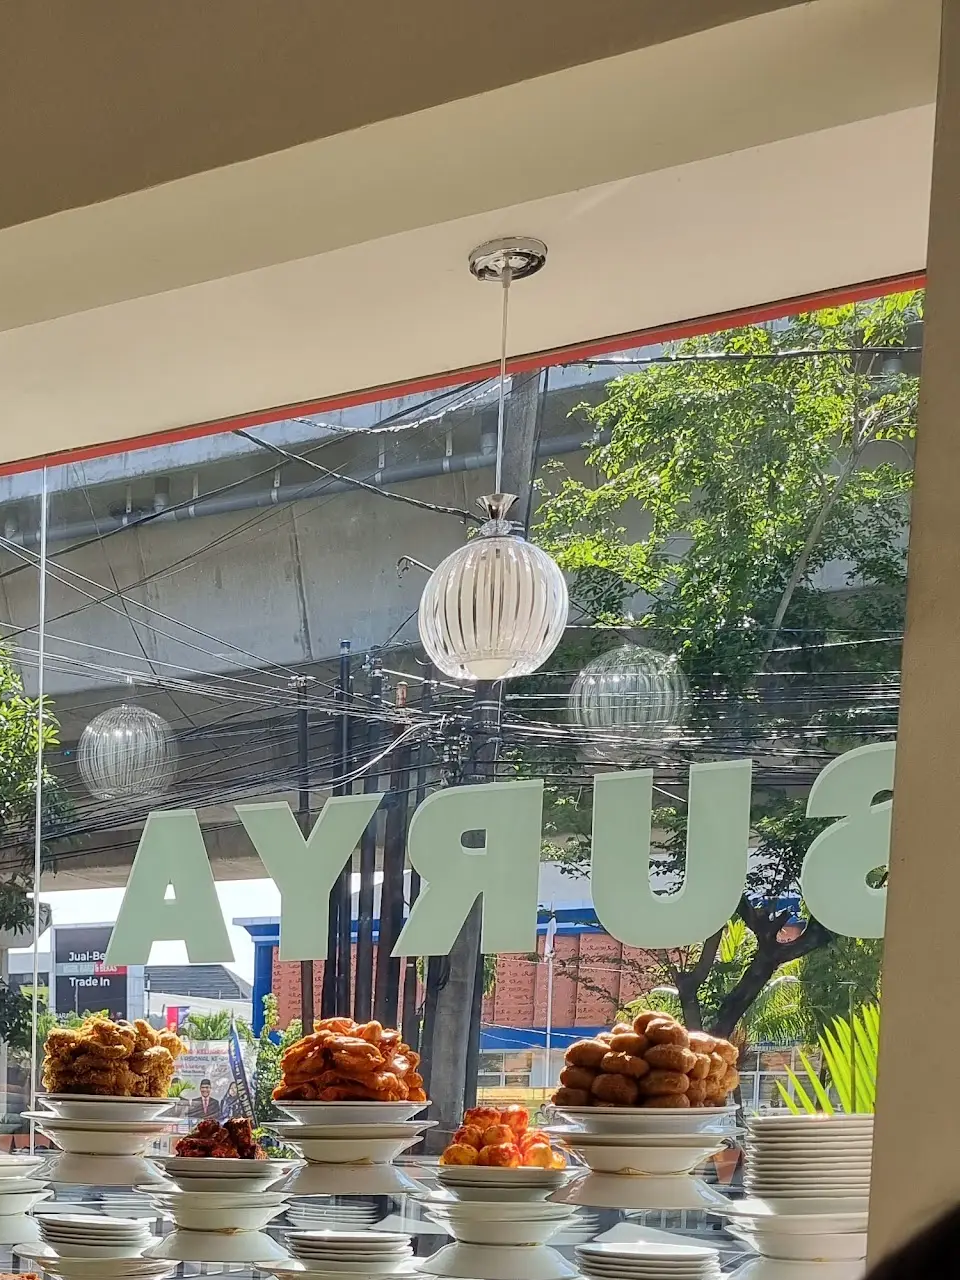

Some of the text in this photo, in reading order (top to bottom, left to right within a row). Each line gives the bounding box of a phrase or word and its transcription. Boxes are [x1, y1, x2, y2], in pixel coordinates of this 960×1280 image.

[68, 951, 106, 962] Jual-Be
[69, 977, 110, 987] Trade In
